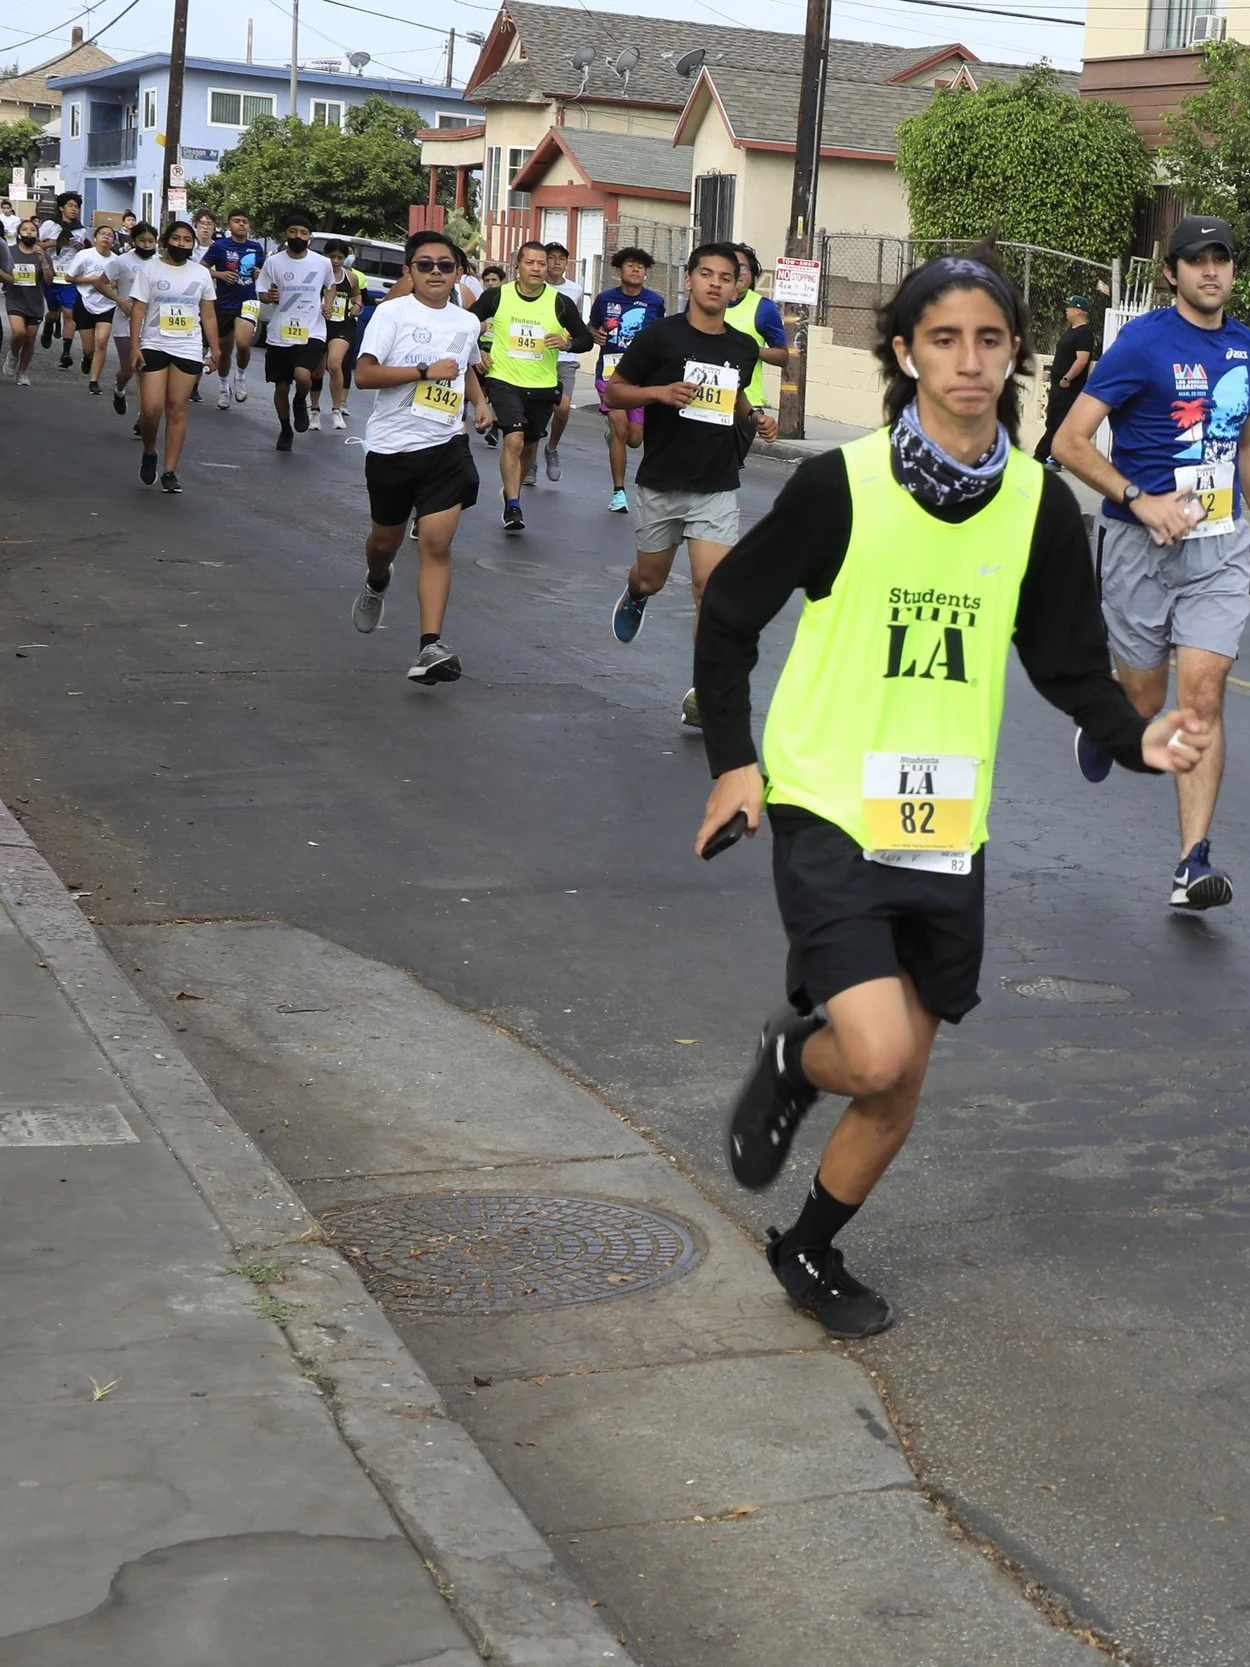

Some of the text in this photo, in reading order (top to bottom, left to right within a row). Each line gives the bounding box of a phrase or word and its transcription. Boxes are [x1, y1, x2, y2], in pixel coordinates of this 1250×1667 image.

[777, 269, 790, 280] NO
[942, 257, 987, 277] LA
[791, 272, 816, 283] STOPPING
[170, 307, 182, 316] LA
[168, 316, 186, 327] 946
[288, 327, 302, 336] 121
[517, 336, 536, 349] 945
[424, 385, 459, 408] 1342
[696, 386, 721, 404] 461
[1195, 475, 1216, 491] LA
[889, 587, 981, 610] Students
[887, 605, 977, 628] run
[882, 624, 969, 684] LA
[897, 771, 936, 795] LA
[900, 801, 935, 834] 82
[950, 859, 965, 872] 82
